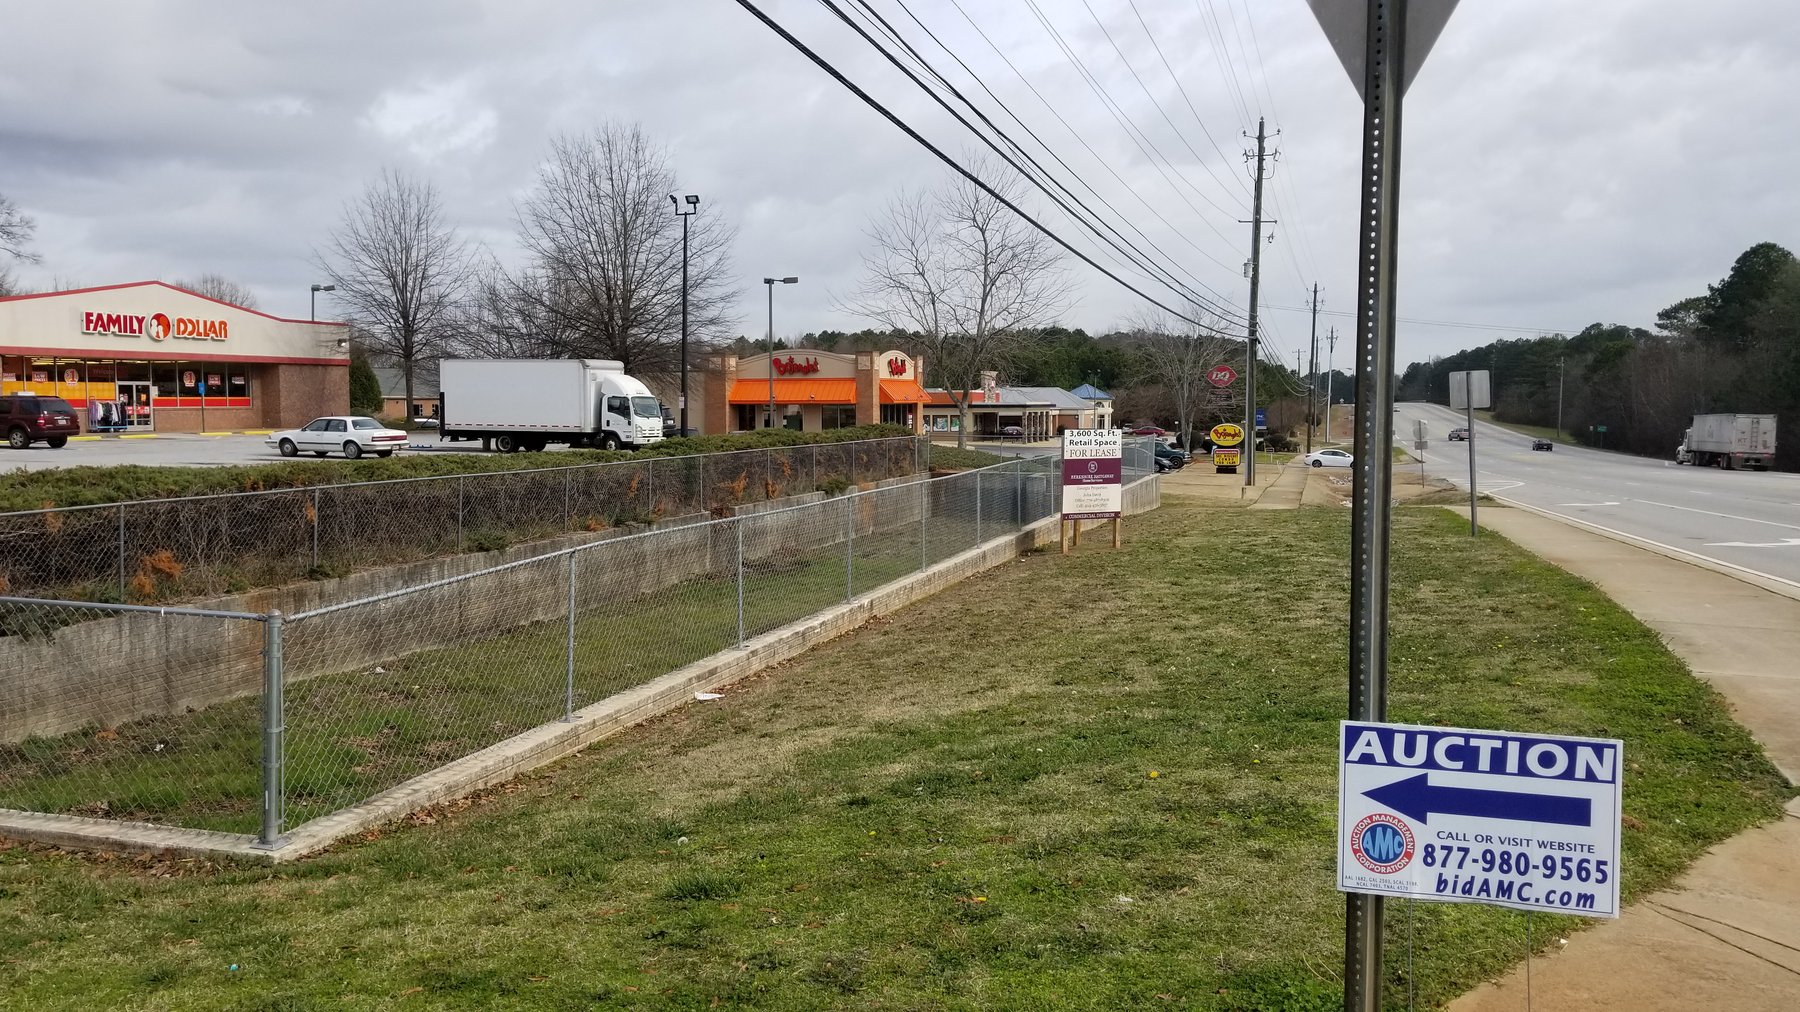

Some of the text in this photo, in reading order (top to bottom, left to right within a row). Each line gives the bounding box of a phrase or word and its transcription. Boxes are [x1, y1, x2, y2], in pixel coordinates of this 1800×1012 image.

[84, 312, 228, 339] FAMILY DOLLAR
[1212, 371, 1230, 380] DQ
[1069, 430, 1092, 438] 3,600
[1093, 430, 1106, 438] Sq.
[1094, 439, 1118, 447] Space
[1069, 448, 1118, 458] FOR LEASE
[1345, 729, 1615, 783] AUCTION
[1352, 814, 1414, 854] AUCTION MANAGEMENT
[1362, 826, 1404, 861] AMC
[1436, 830, 1596, 854] CALL OR VISIT WEBSITE
[1356, 852, 1410, 874] CORPORATION
[1422, 843, 1609, 885] 877-980-9565
[1435, 872, 1596, 909] bidAMC.com
